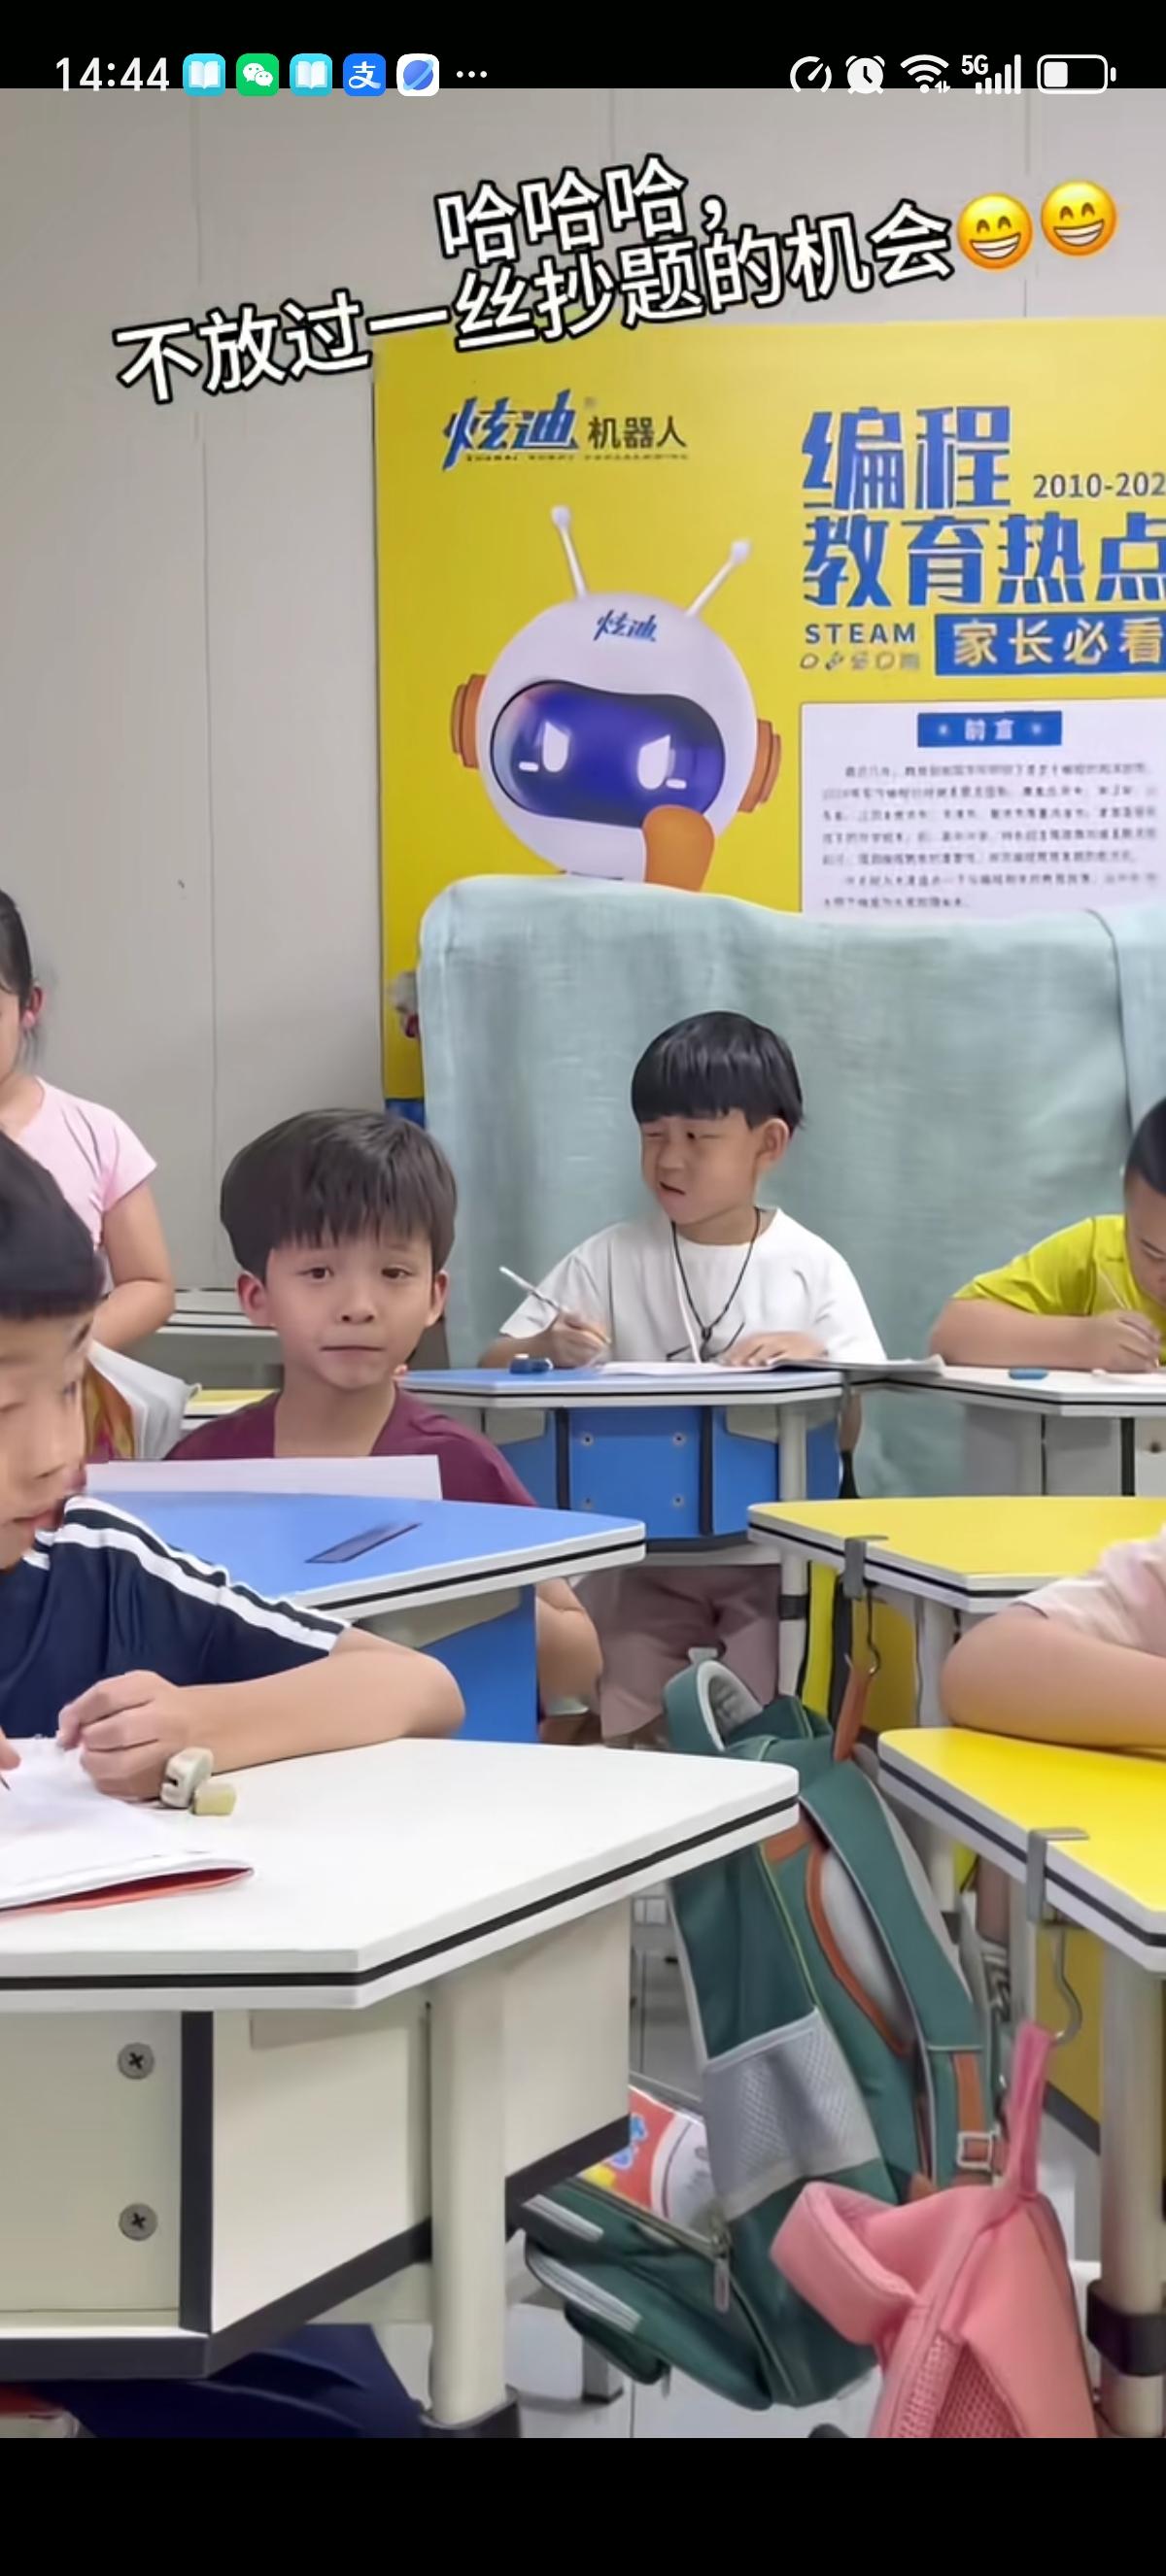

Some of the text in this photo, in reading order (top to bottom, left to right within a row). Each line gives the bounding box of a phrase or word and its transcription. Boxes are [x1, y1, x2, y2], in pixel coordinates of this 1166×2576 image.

[442, 389, 688, 471] 炫迪 机器人
[802, 406, 1011, 510] 编程
[1033, 471, 1166, 498] 2010-202
[803, 511, 1166, 607] 教育热点
[593, 609, 657, 642] 炫迪
[805, 623, 915, 644] STEAM
[952, 618, 1164, 667] 家长必看
